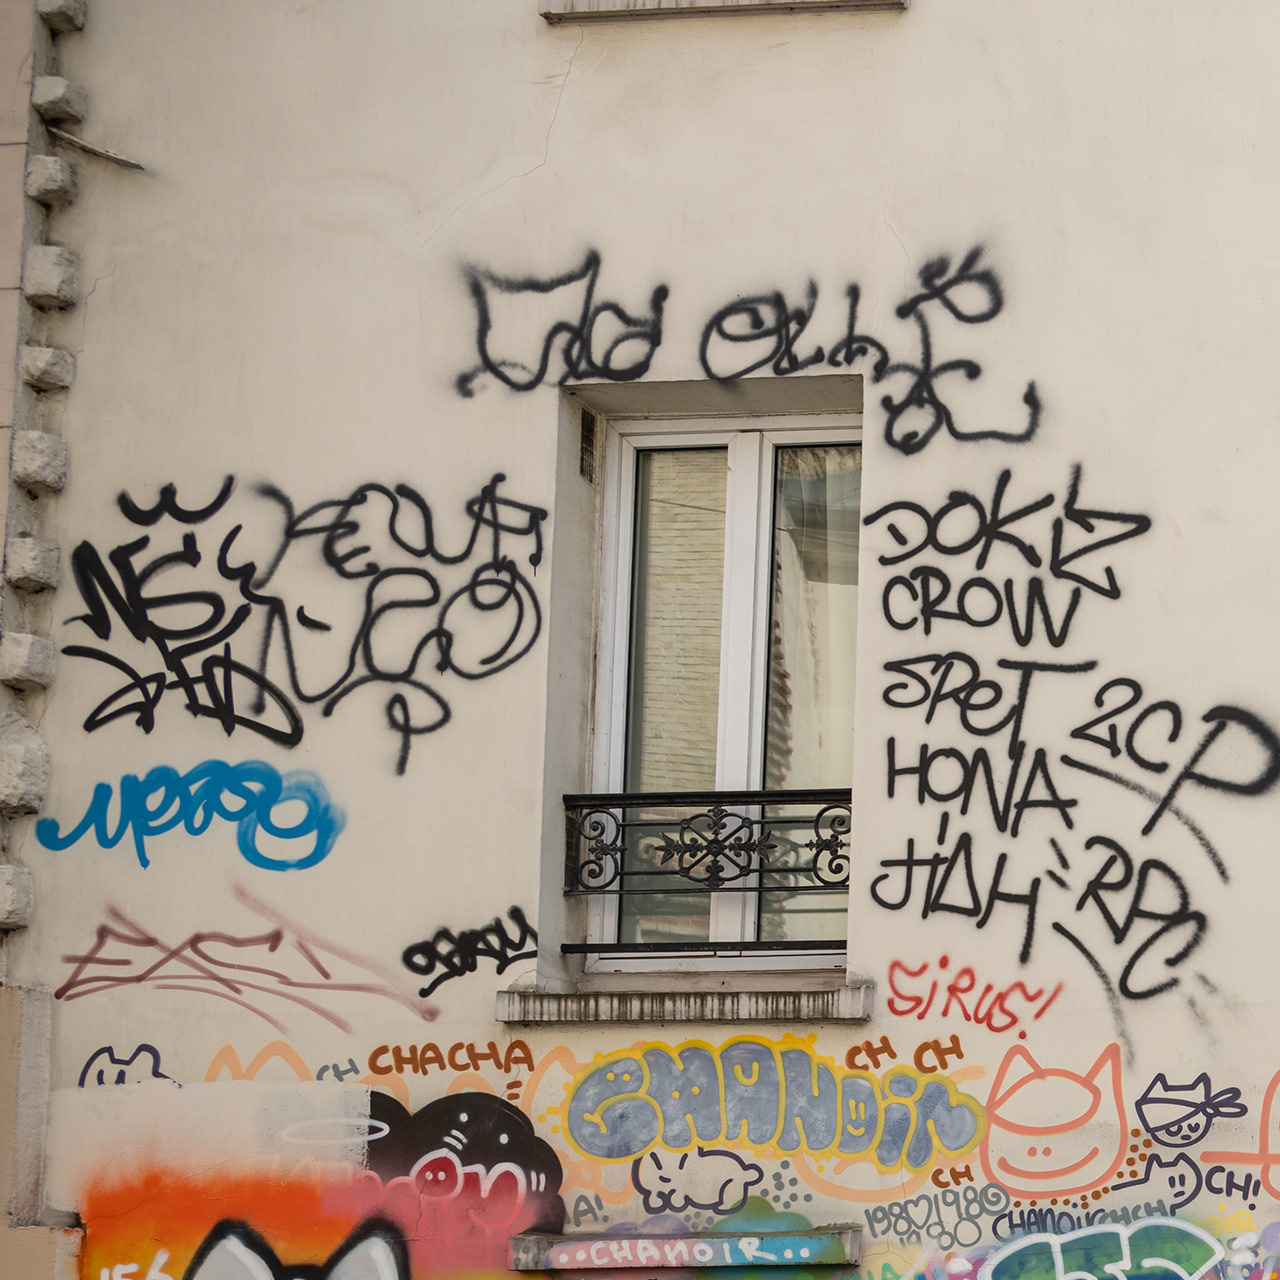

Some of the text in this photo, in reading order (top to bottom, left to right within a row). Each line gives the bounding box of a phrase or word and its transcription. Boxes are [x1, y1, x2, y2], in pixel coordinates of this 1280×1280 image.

[882, 566, 1082, 647] CROW
[887, 738, 1078, 838] HONA
[368, 1039, 534, 1077] CHACHA
[845, 1034, 964, 1074] CH CH
[931, 1164, 974, 1189] CH
